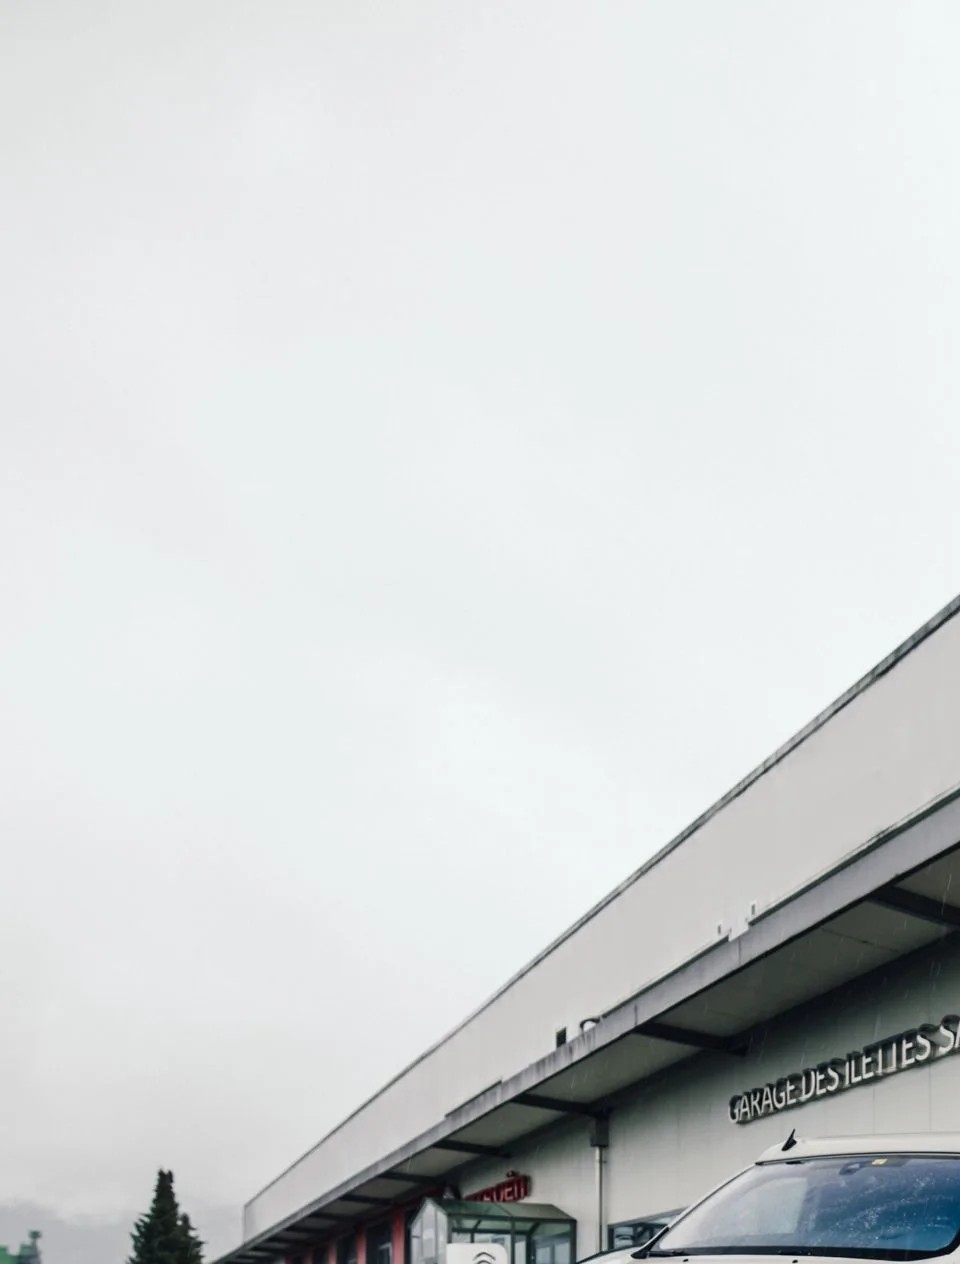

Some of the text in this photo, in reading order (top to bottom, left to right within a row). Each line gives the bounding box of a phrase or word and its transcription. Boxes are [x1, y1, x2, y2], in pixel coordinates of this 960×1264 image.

[727, 1077, 797, 1124] GARAGE
[799, 1064, 839, 1100] DES
[845, 1031, 931, 1086] ILETTES
